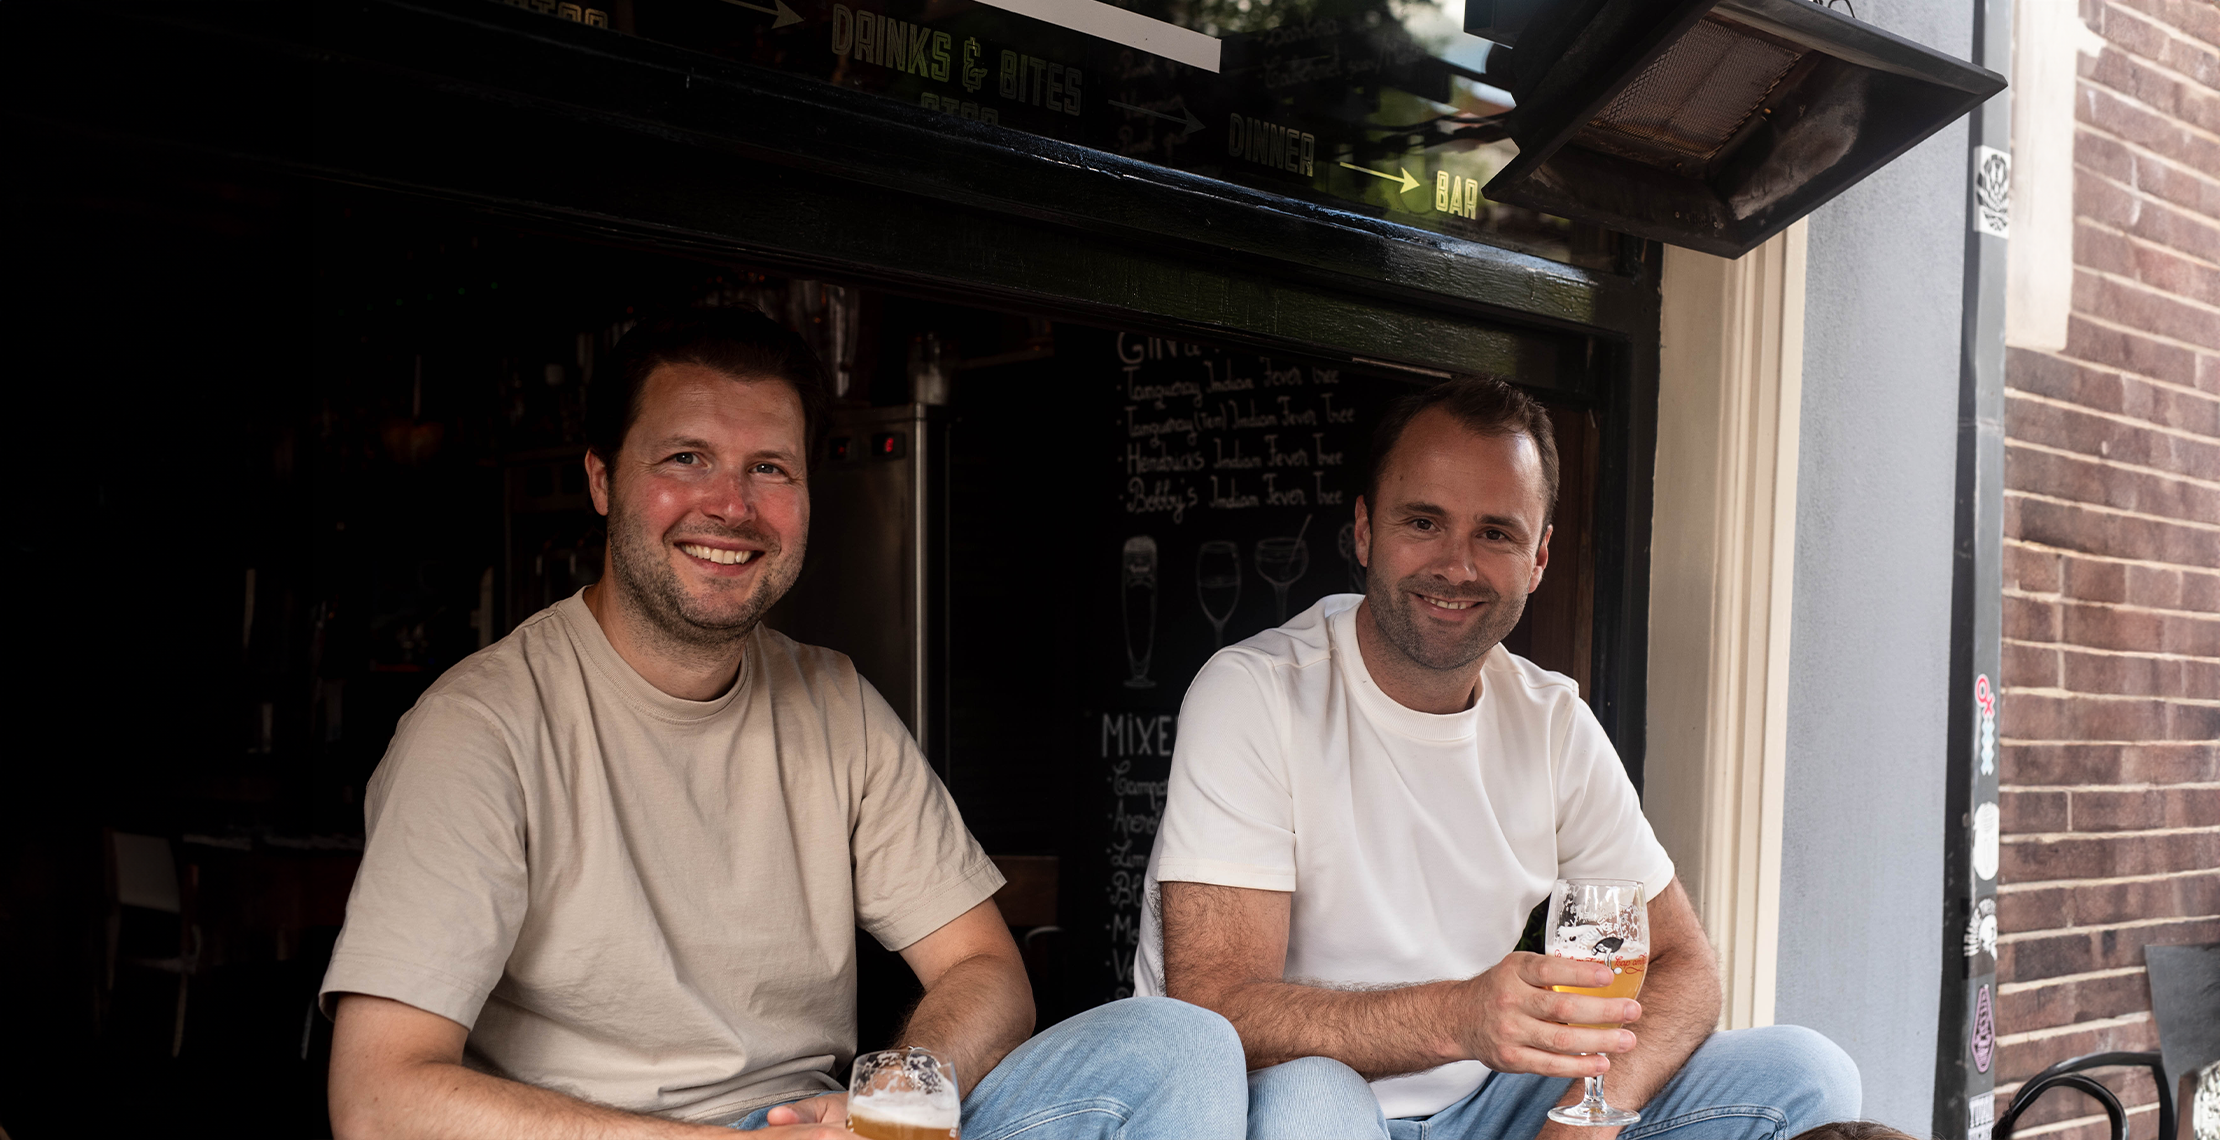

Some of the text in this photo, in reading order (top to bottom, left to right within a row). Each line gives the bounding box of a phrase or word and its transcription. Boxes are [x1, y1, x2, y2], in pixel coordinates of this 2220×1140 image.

[831, 2, 952, 83] DRINKS
[961, 36, 988, 93] &
[998, 48, 1083, 117] BITES
[1228, 111, 1316, 177] DINNER
[1435, 169, 1479, 221] BAR
[1204, 359, 1253, 392] Indian
[1260, 357, 1304, 387] Fever
[1229, 400, 1277, 428] Indian
[1278, 397, 1318, 425] Fever
[1320, 393, 1355, 423] Tree
[1213, 439, 1261, 468] Indian
[1265, 436, 1309, 466] Fever
[1313, 434, 1343, 465] Tree
[1127, 472, 1343, 523] Bobby's Indian Fever Tree
[1103, 714, 1179, 756] MiXE
